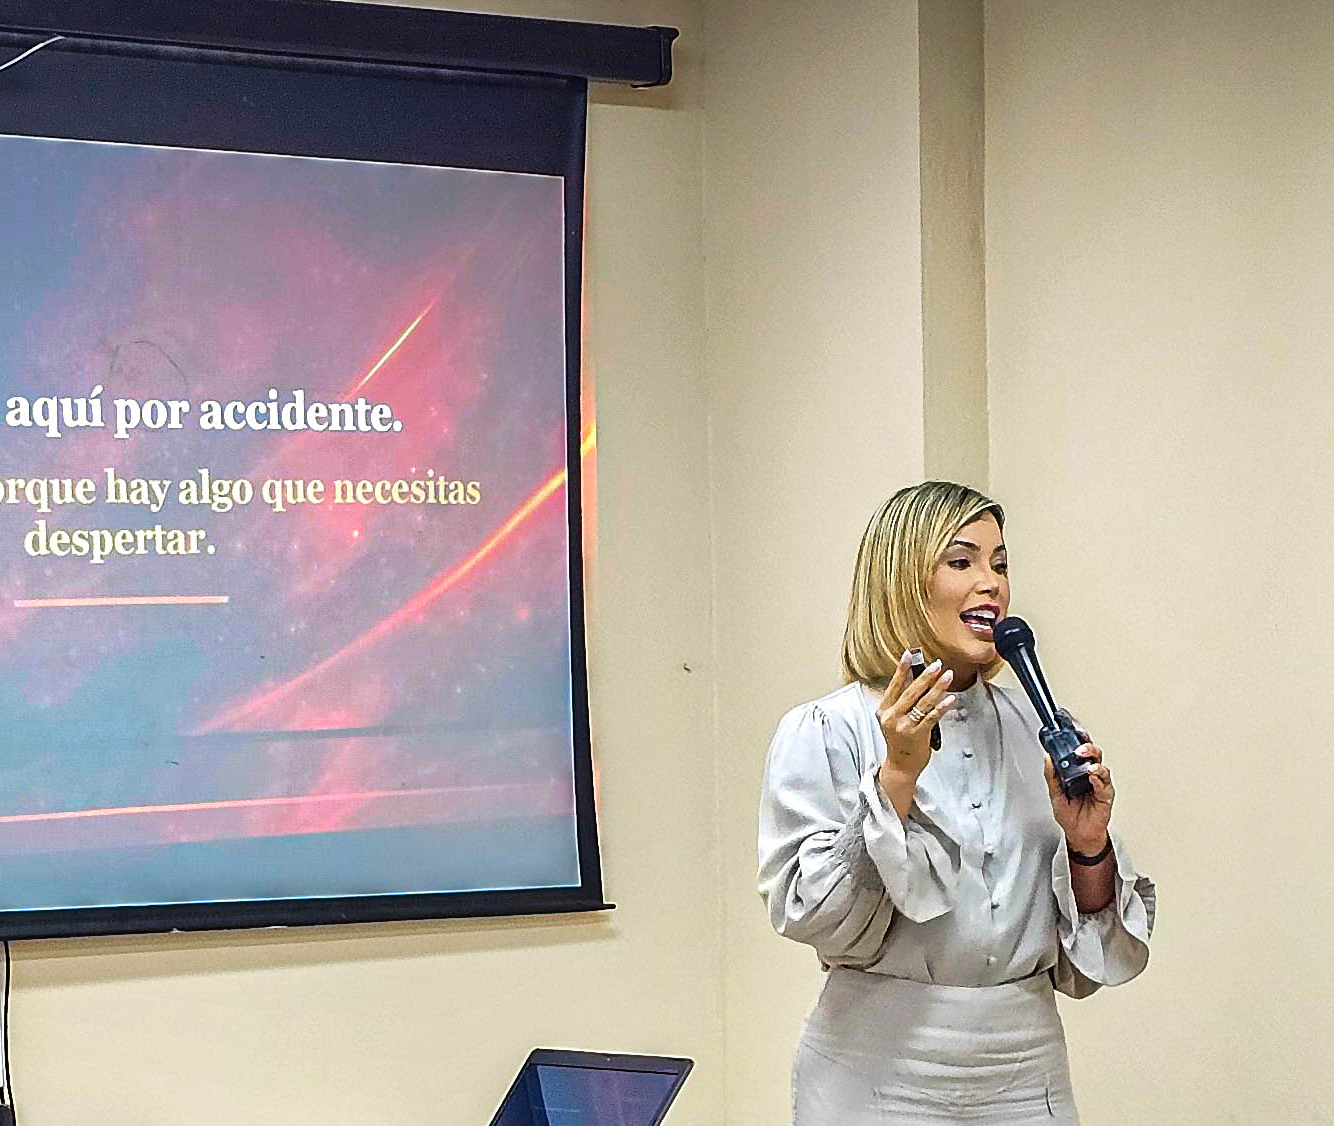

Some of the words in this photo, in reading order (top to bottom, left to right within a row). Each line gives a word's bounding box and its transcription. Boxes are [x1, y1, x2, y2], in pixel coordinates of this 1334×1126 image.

[5, 384, 105, 439] aquí
[113, 398, 190, 439] por
[199, 388, 403, 432] accidente.
[103, 467, 172, 513] hay
[178, 467, 254, 513] algo
[261, 478, 325, 513] que
[333, 468, 481, 505] necesitas
[23, 519, 216, 564] despertar.
